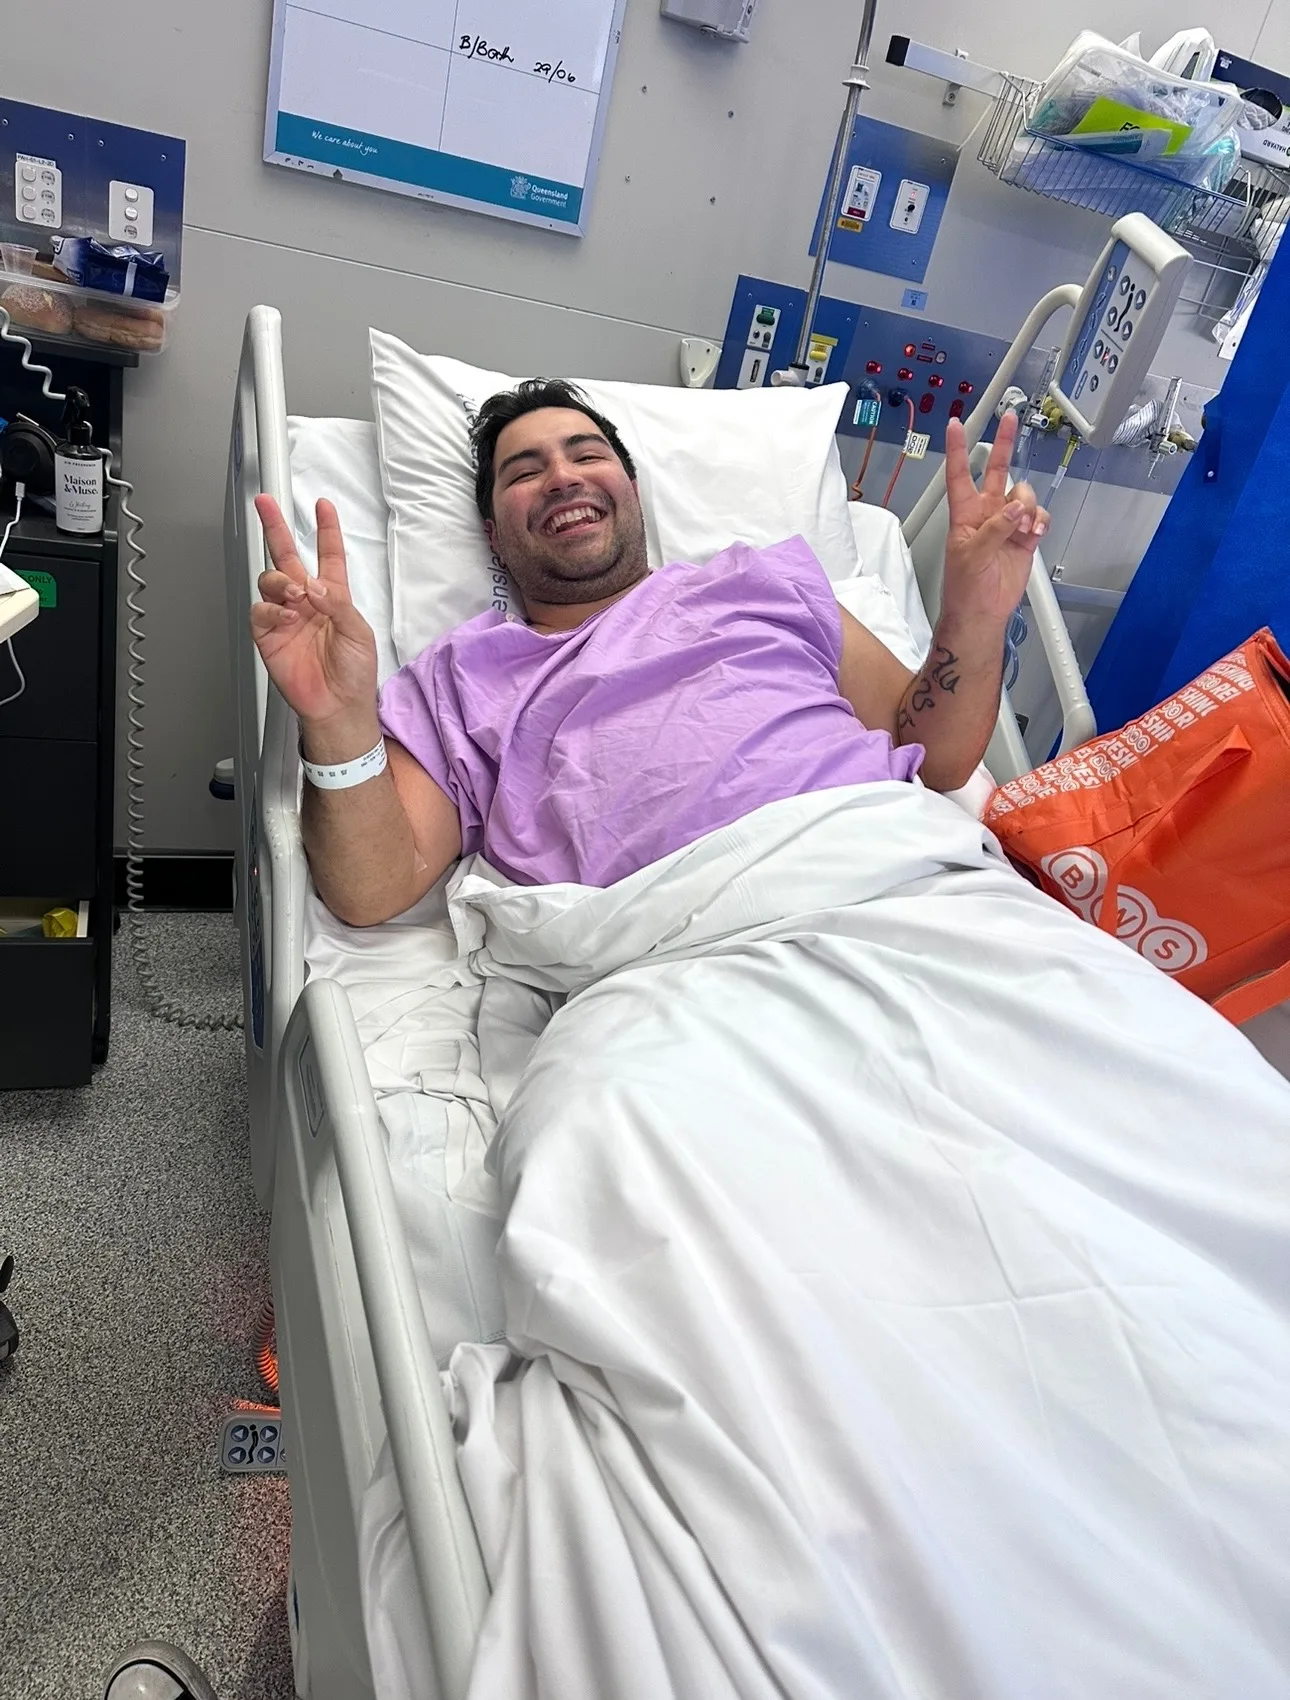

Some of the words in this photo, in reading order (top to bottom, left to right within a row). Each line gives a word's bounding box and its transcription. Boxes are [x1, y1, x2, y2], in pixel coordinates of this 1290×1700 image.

[312, 130, 322, 140] We
[324, 136, 341, 145] care
[342, 139, 363, 149] about
[360, 144, 378, 156] you
[531, 184, 568, 200] Queensland
[530, 193, 566, 208] Government
[64, 473, 97, 486] Maison
[28, 575, 52, 584] ONLY
